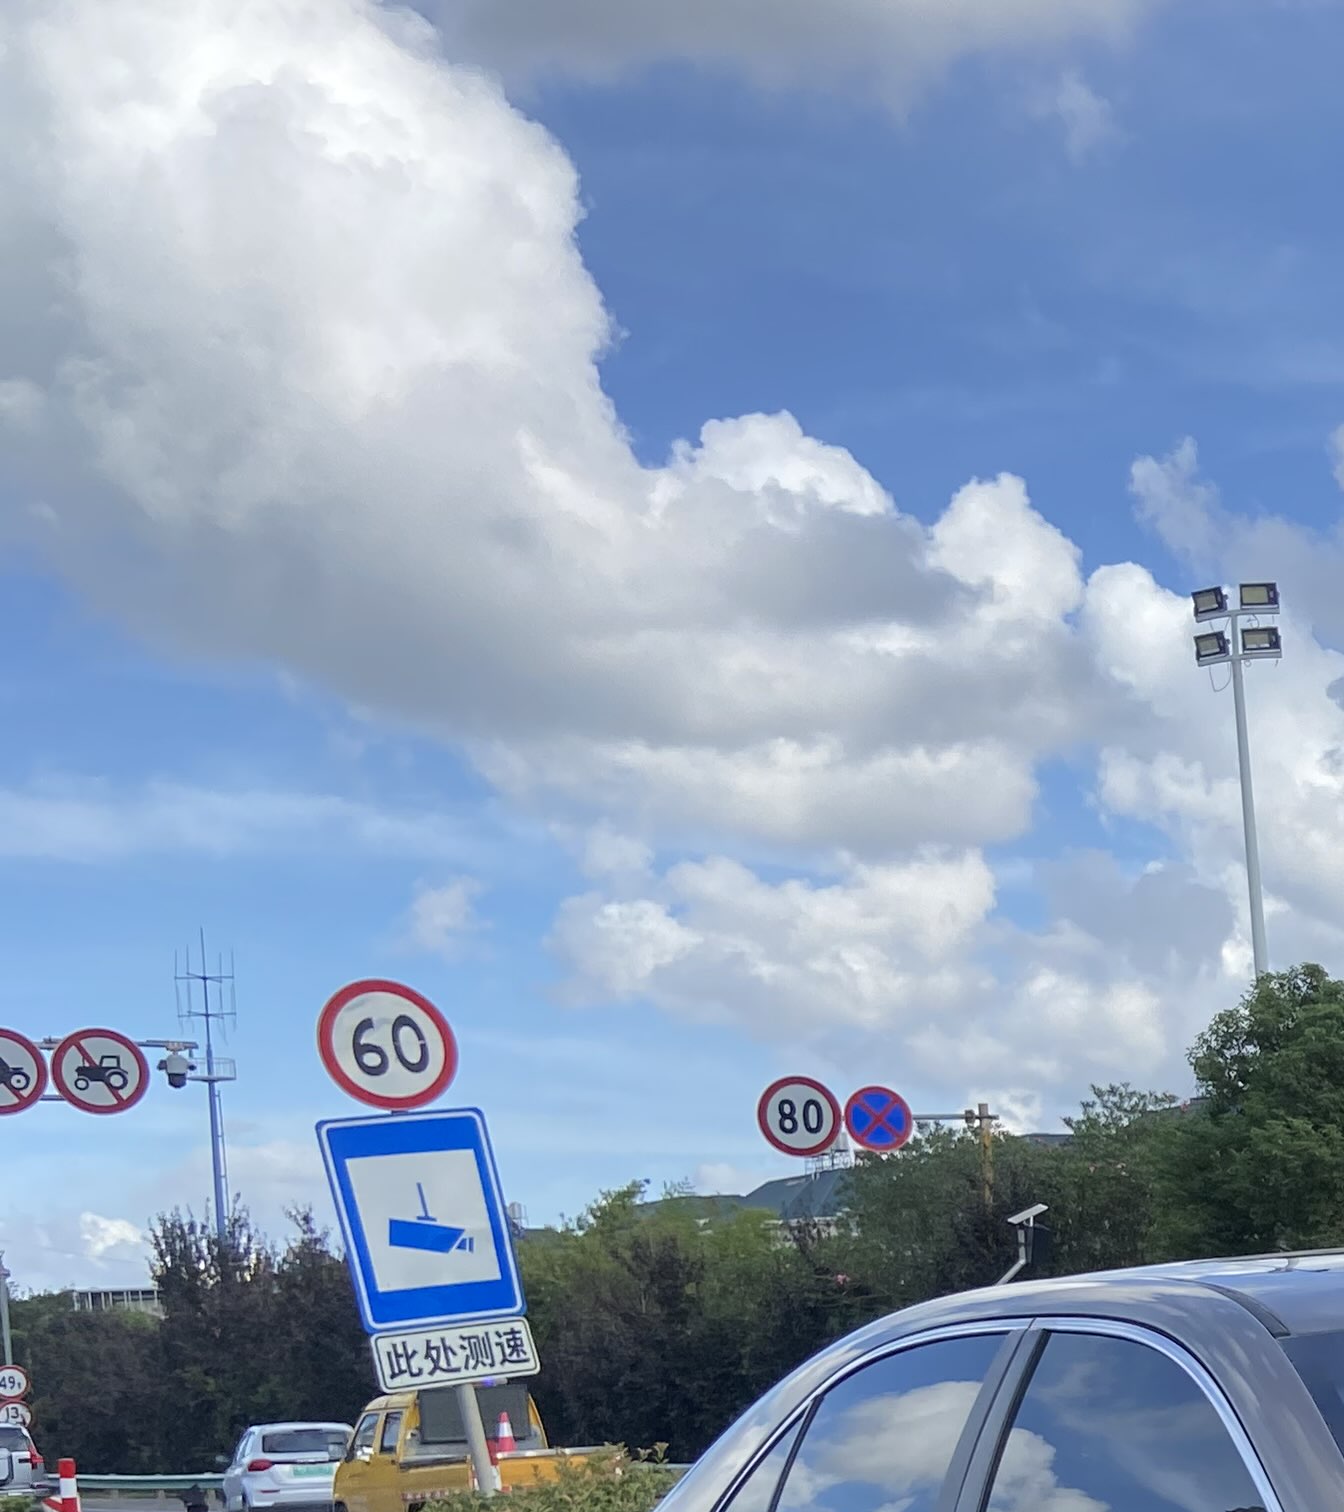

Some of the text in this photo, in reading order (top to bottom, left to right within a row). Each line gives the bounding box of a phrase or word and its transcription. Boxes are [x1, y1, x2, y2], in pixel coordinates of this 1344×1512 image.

[352, 1014, 430, 1076] 60
[778, 1099, 824, 1134] 80
[386, 1327, 531, 1380] 此处测速
